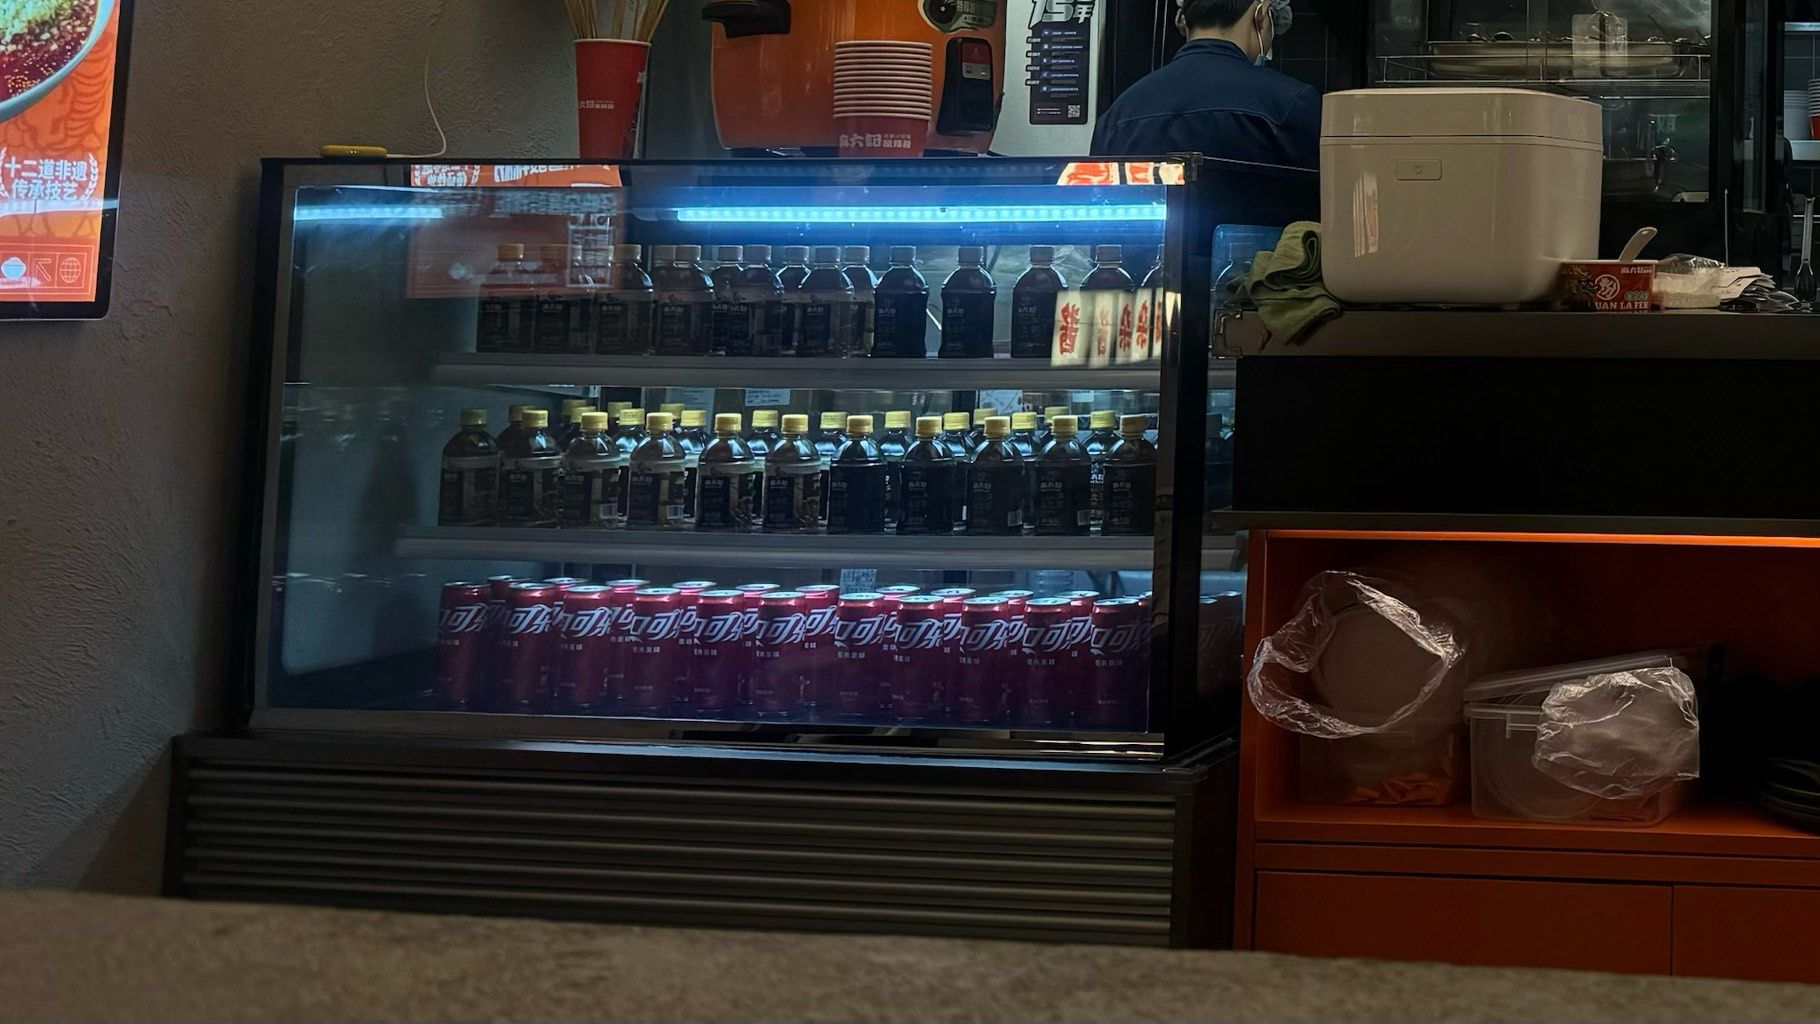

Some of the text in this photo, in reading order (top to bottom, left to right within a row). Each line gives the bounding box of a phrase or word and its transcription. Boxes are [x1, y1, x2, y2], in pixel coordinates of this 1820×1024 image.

[4, 156, 88, 181] 十二道非遗
[12, 179, 78, 201] 传承技艺
